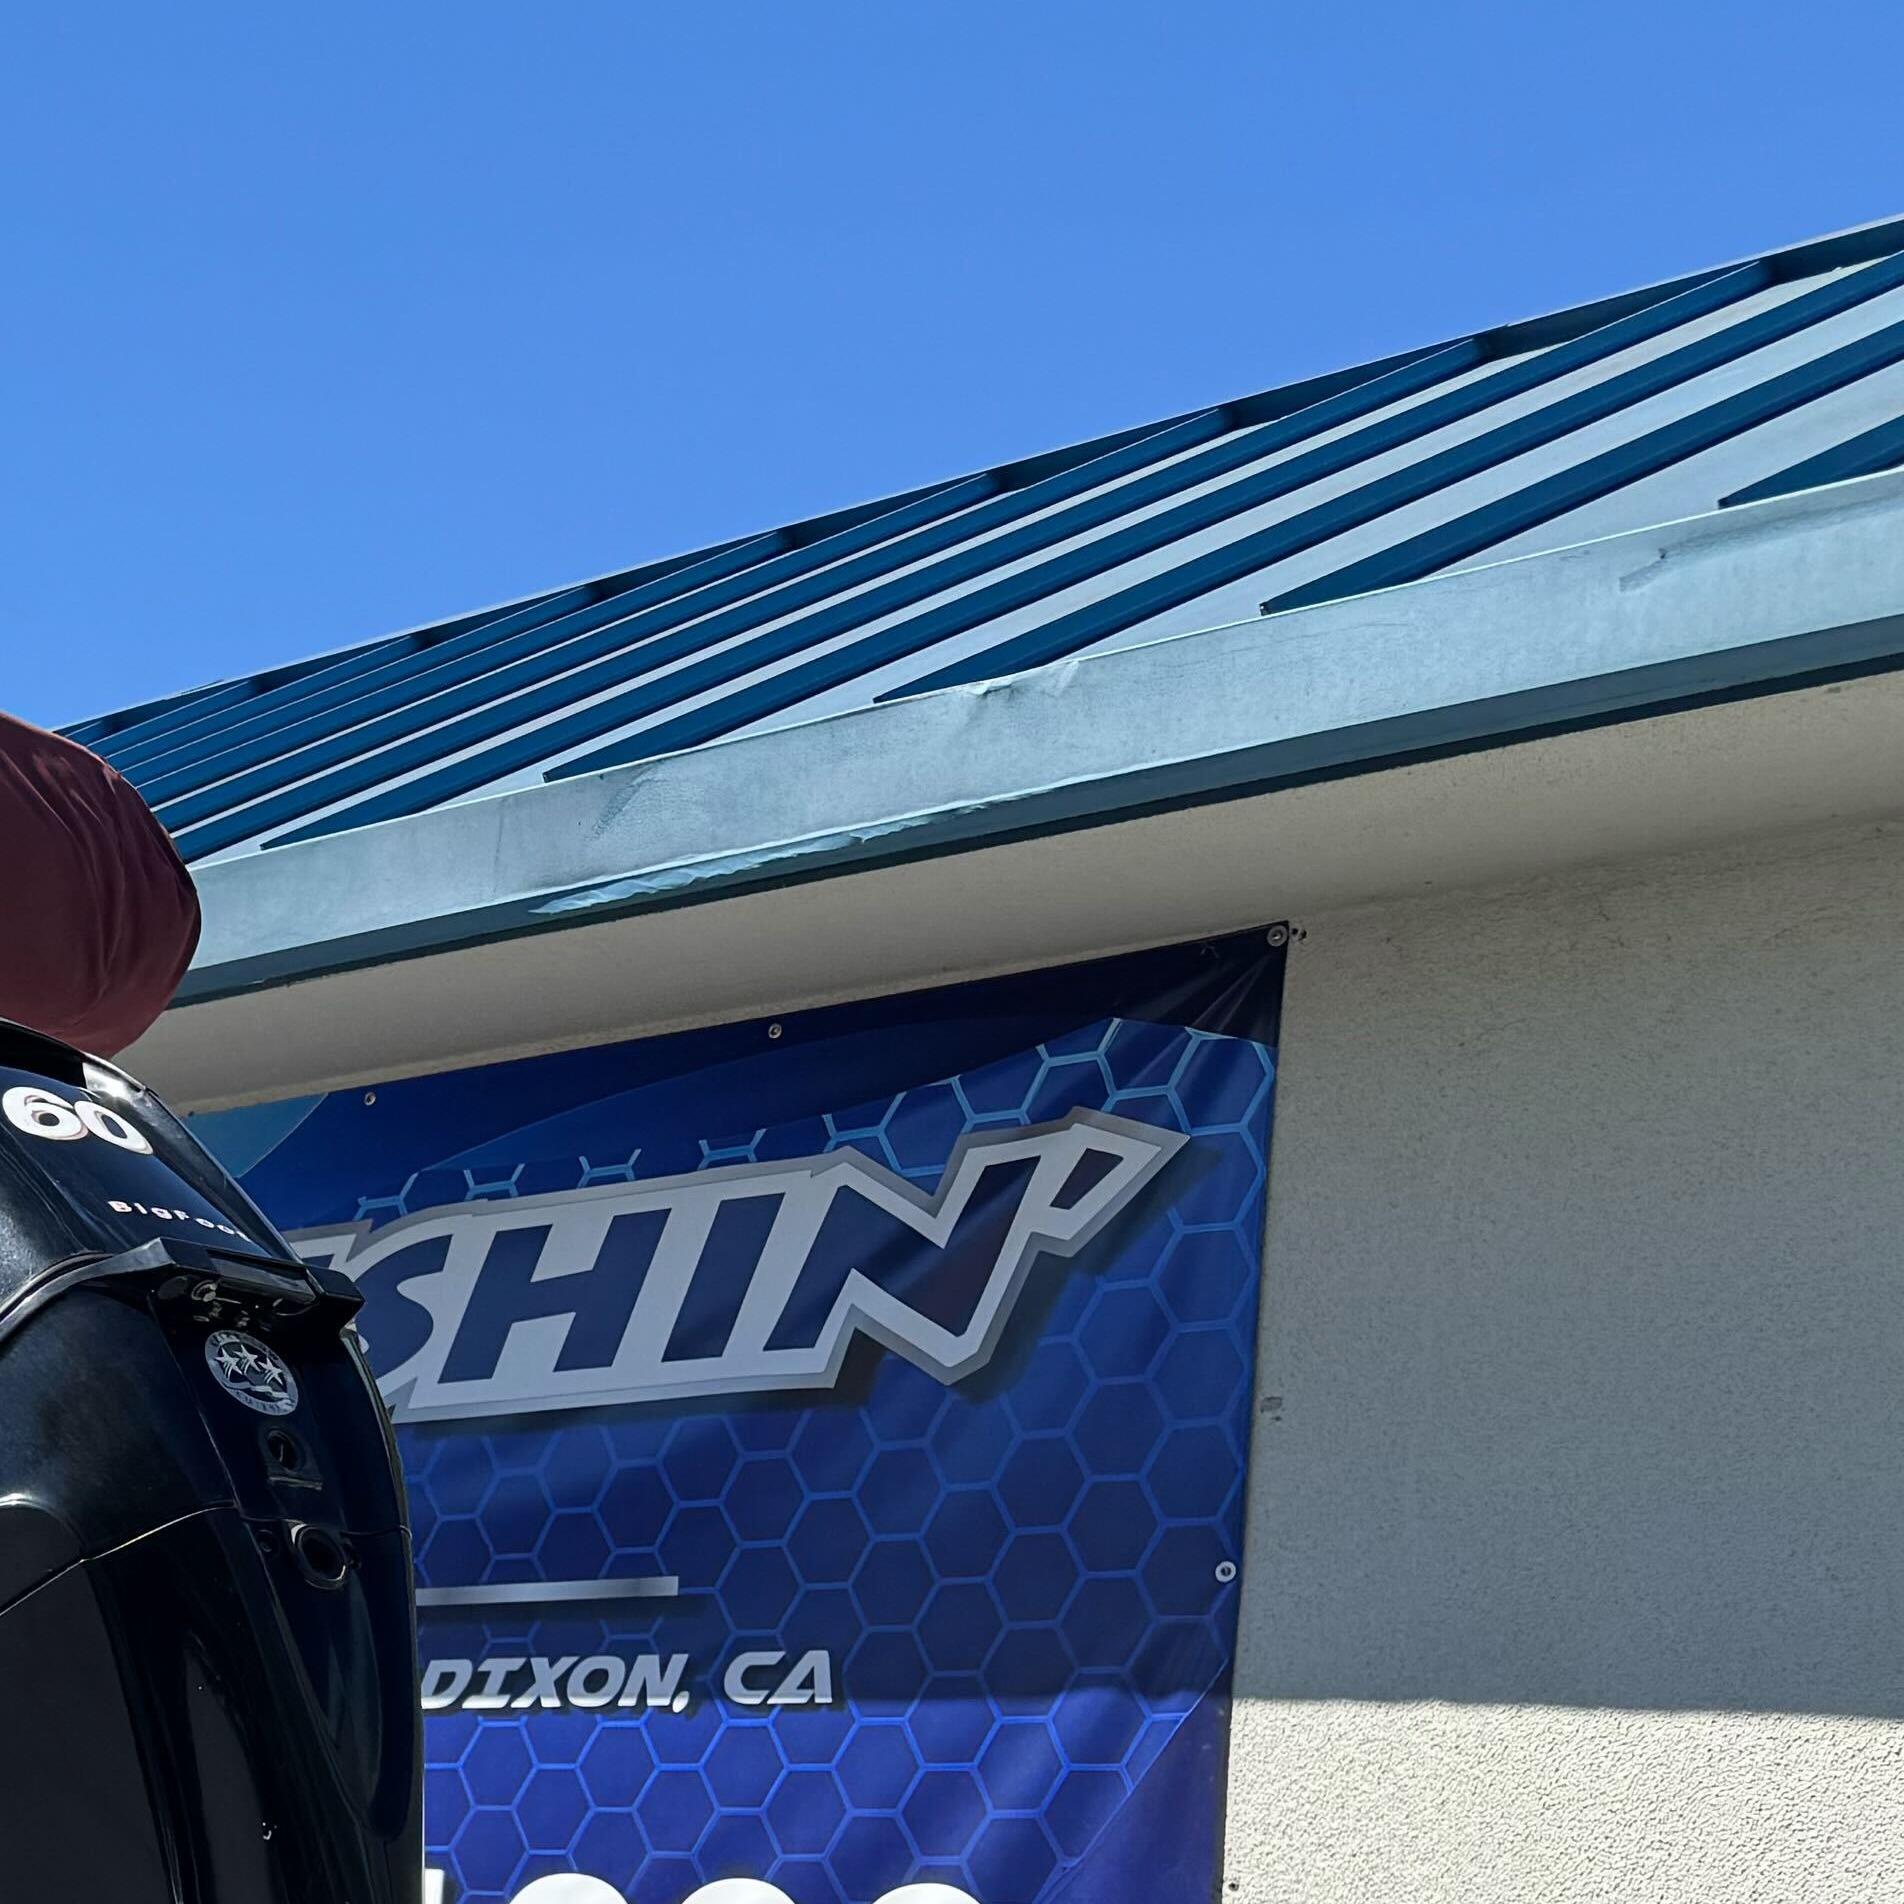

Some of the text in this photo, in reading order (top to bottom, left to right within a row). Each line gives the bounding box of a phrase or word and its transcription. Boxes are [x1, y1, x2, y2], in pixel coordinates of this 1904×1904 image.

[2, 1086, 153, 1155] 60
[295, 1138, 1144, 1396] SHIN'
[420, 1649, 833, 1713] DIXON, CA
